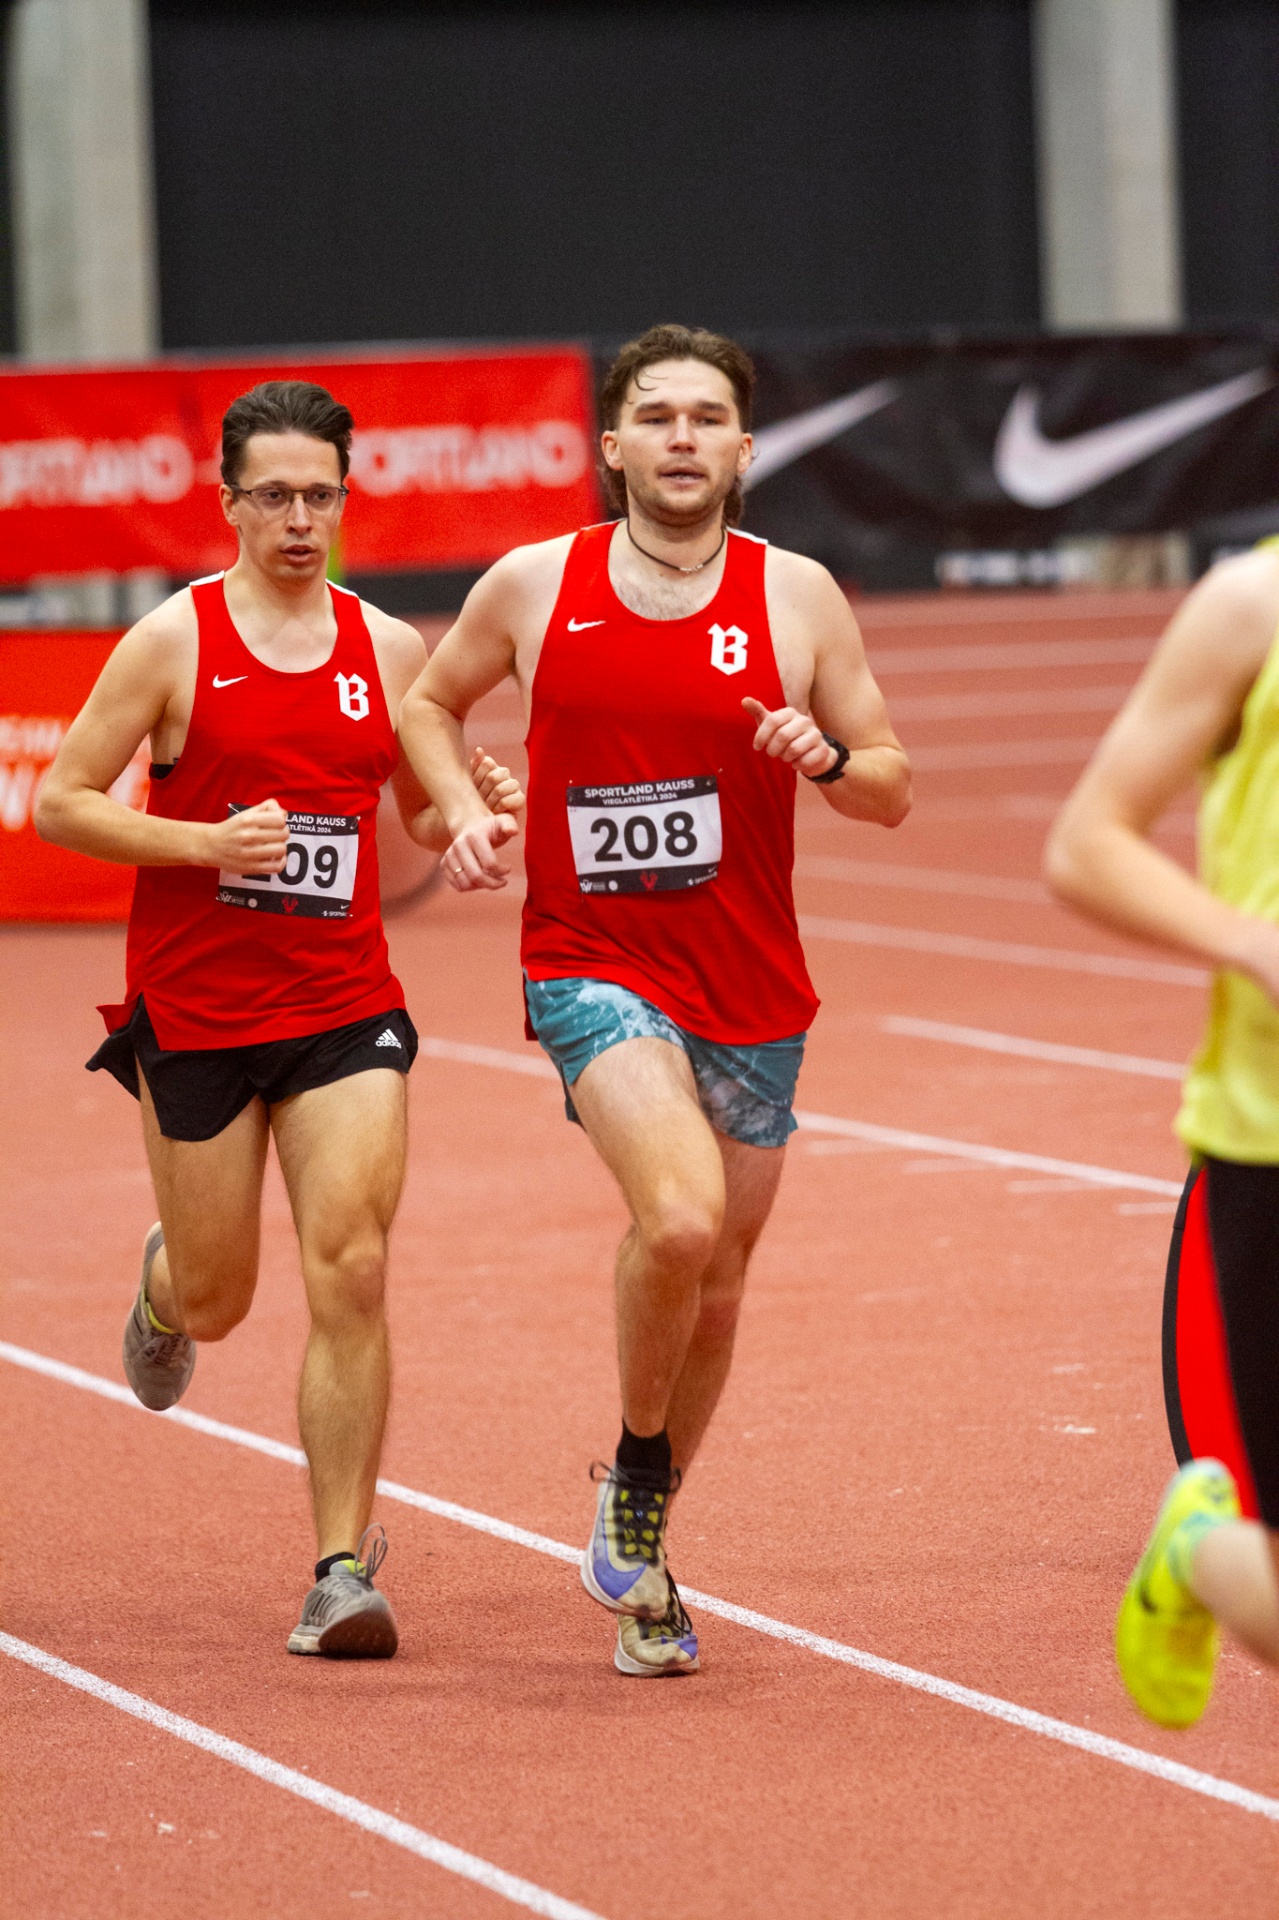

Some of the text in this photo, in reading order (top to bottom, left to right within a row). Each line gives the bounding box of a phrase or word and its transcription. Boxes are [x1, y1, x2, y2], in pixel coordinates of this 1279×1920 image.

[584, 779, 695, 798] SPORTLAND KAUSS
[659, 792, 678, 801] 2024
[316, 816, 347, 827] KAUSS
[590, 811, 698, 862] 208
[241, 842, 339, 889] 09
